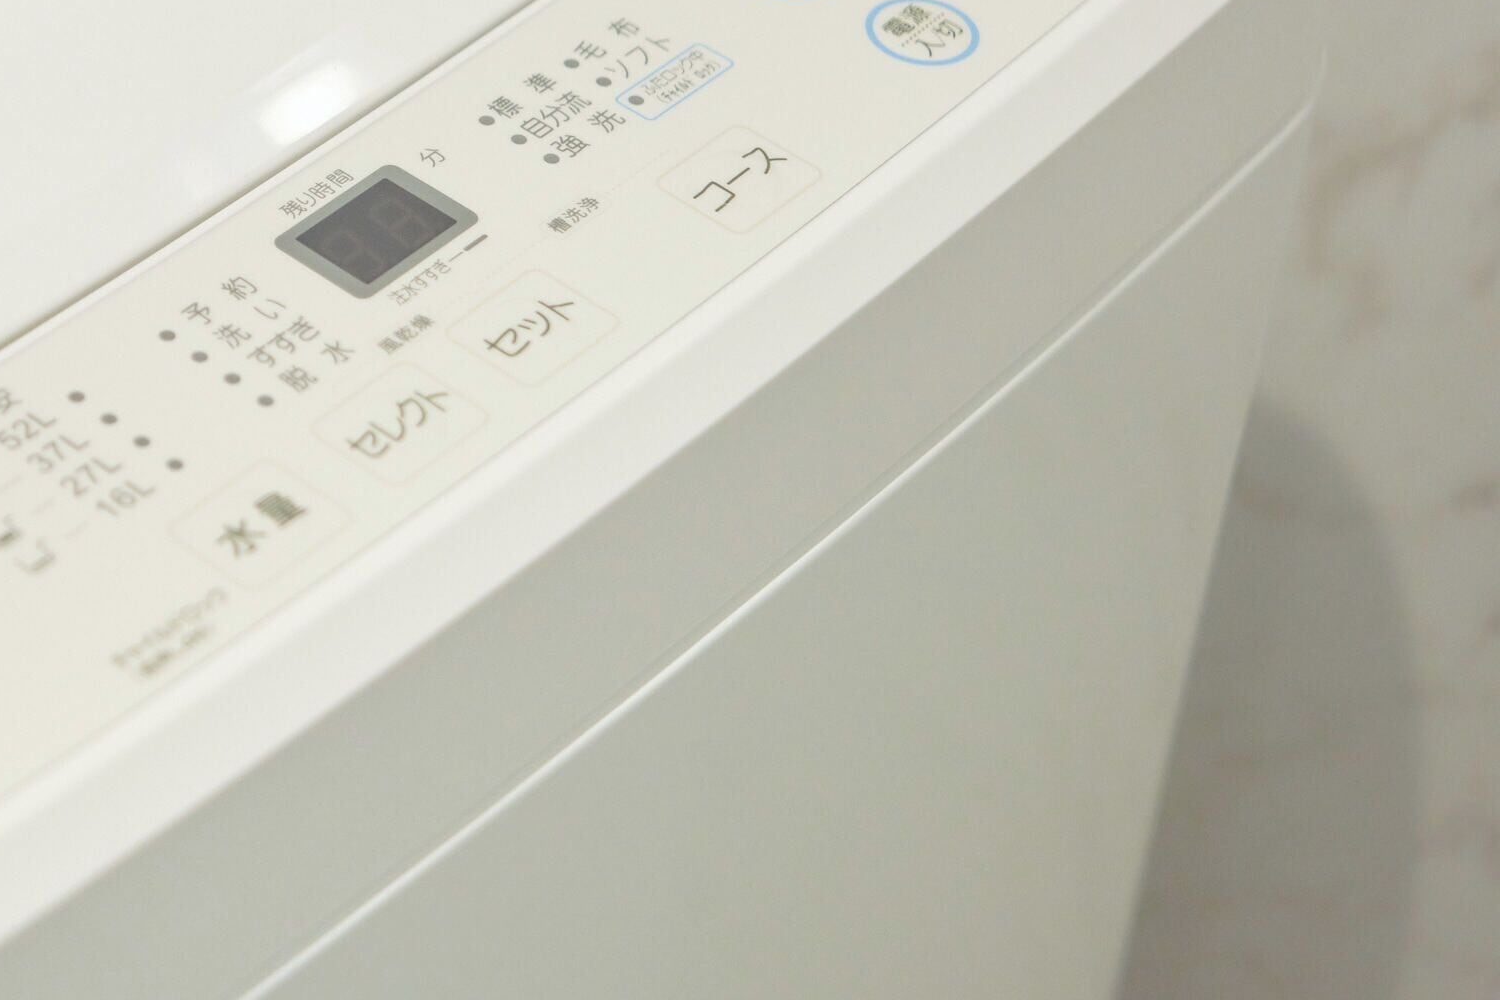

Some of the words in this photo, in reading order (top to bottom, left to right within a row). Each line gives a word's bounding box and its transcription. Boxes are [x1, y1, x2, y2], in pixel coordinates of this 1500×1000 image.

[882, 4, 931, 36] 電源
[603, 35, 672, 80] ソフト
[520, 91, 592, 139] 自分流
[419, 147, 447, 168] 分
[693, 147, 789, 213] コース
[278, 168, 354, 219] 残り時間
[547, 196, 600, 235] 槽洗浄
[388, 258, 452, 306] 注水すすぎ
[246, 315, 321, 368] すすぎ
[377, 314, 435, 355] 風乾燥
[483, 300, 575, 357] セット
[345, 389, 449, 460] セレクト
[27, 435, 90, 473] 37L
[60, 457, 123, 497] 27L
[96, 480, 156, 517] 16L
[216, 491, 308, 557] 水量
